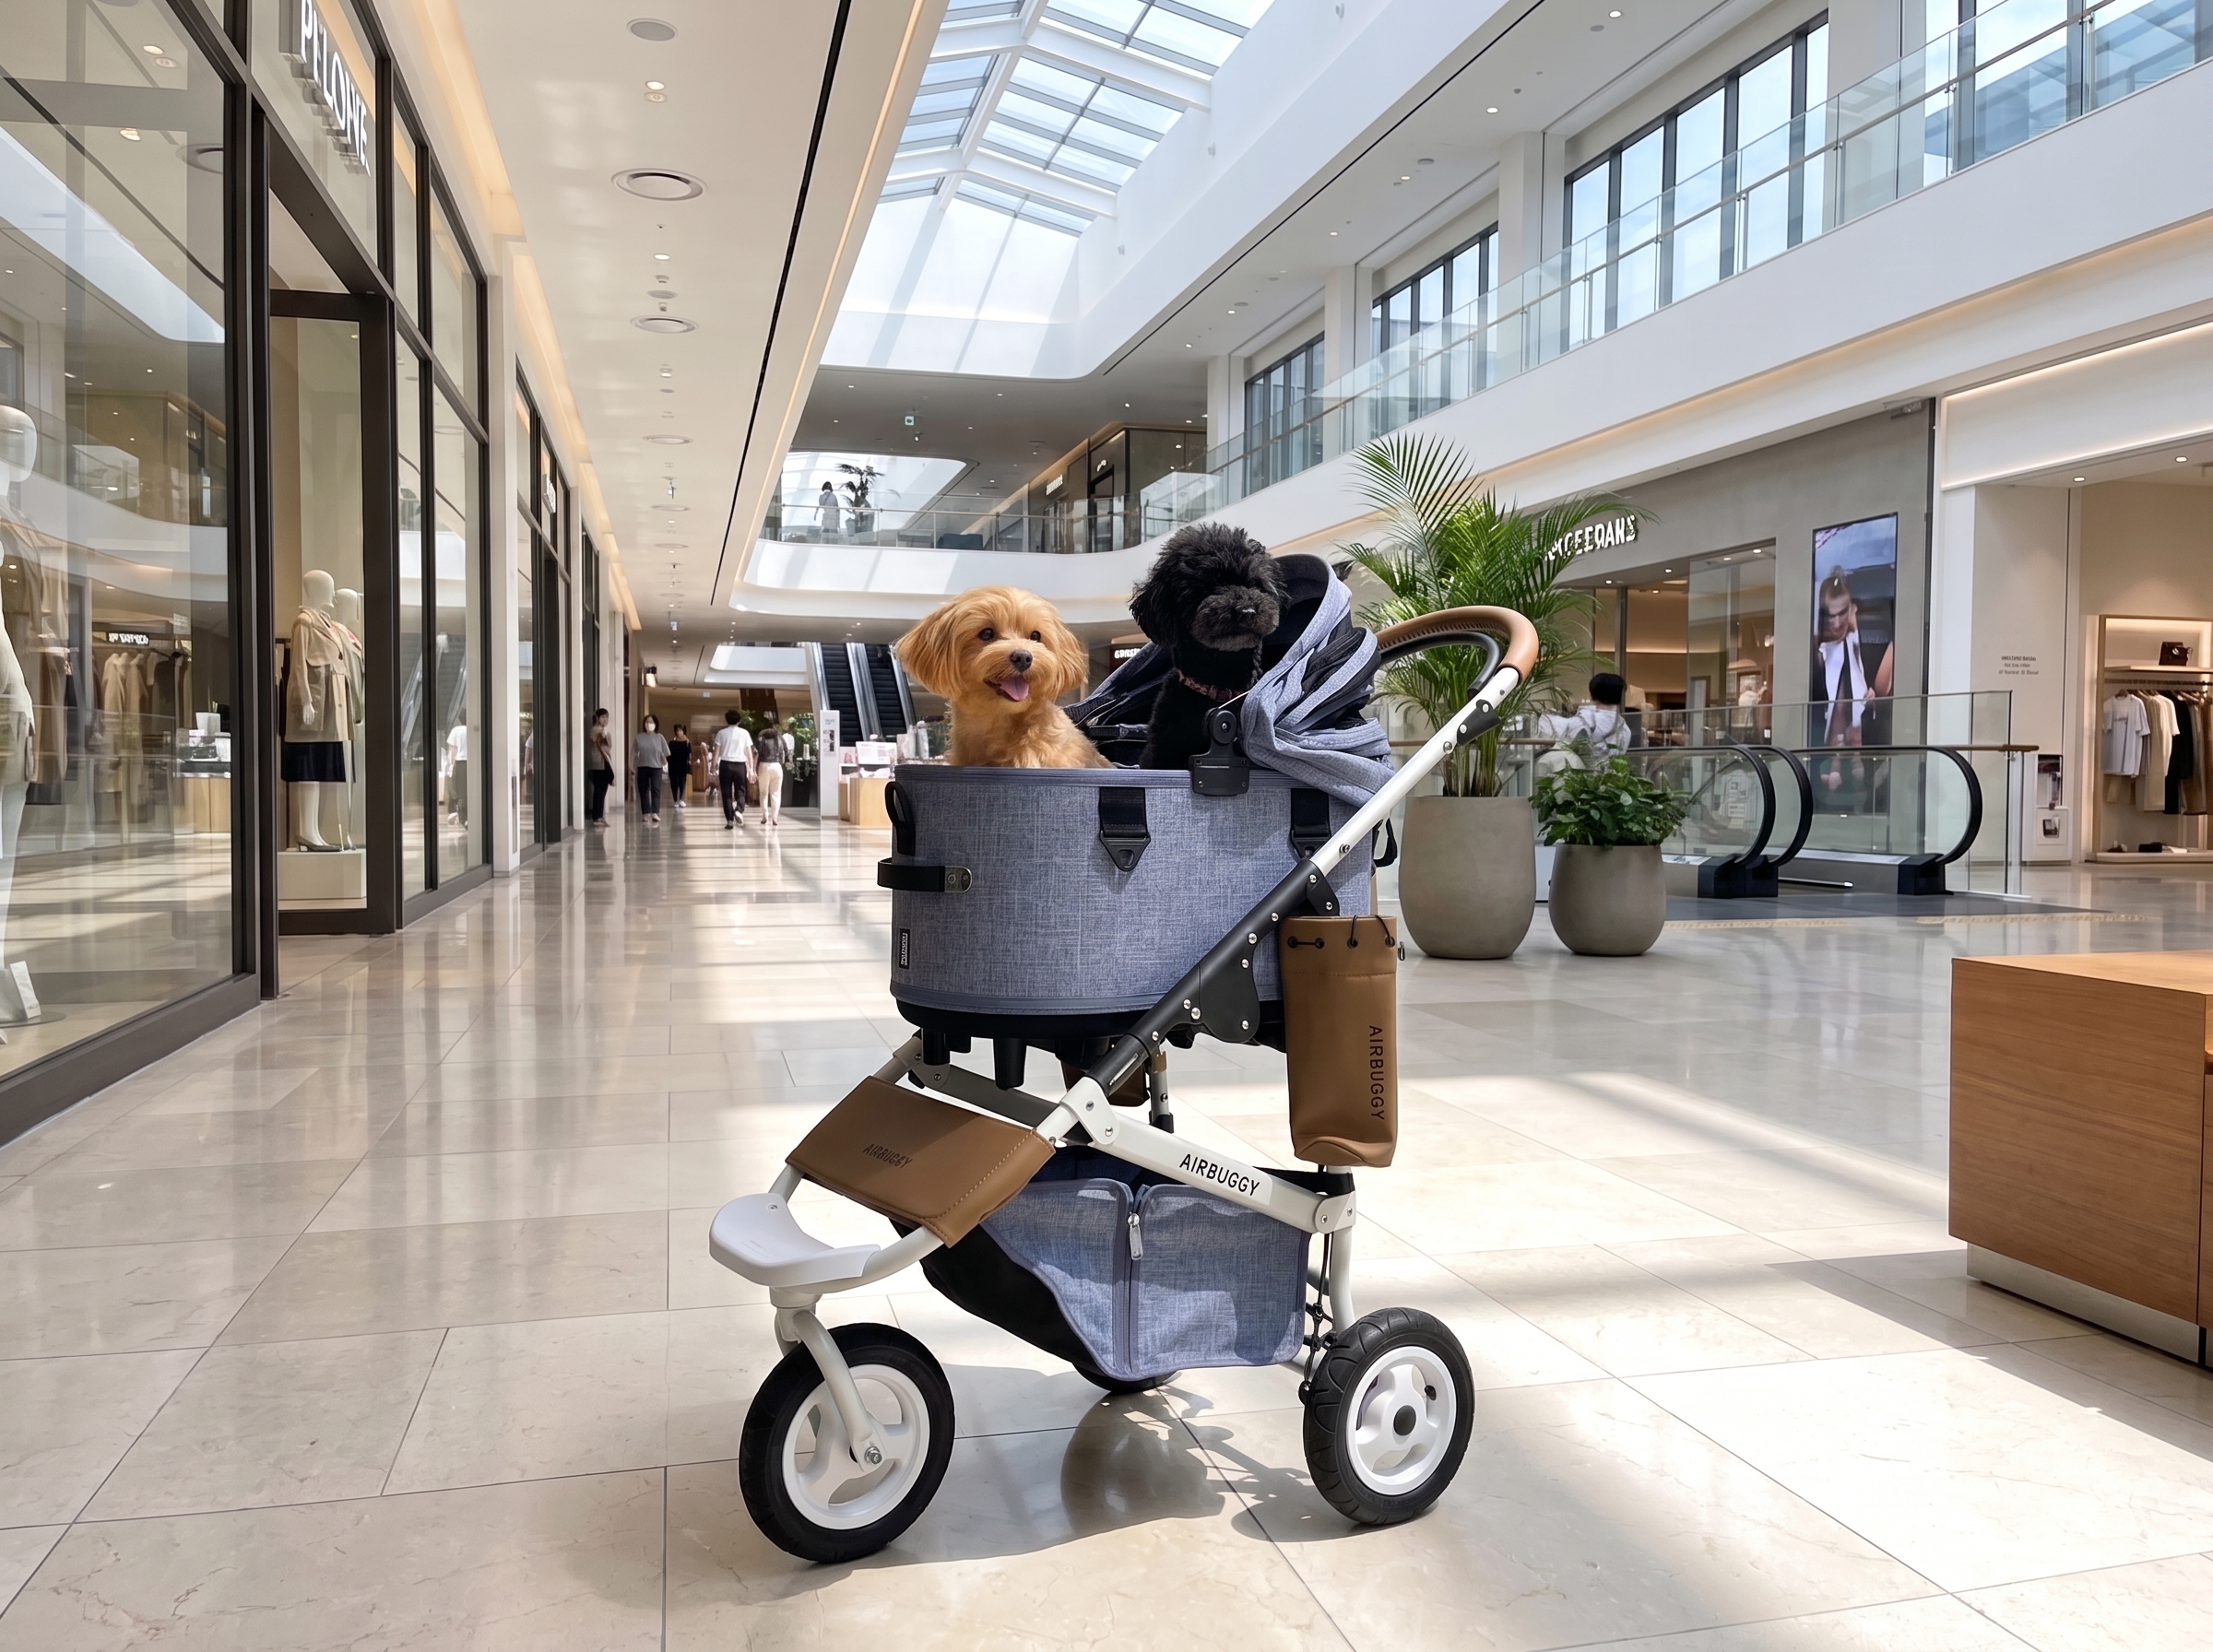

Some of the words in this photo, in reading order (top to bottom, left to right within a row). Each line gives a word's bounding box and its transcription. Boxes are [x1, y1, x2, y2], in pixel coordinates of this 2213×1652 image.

[1369, 1025, 1385, 1120] AIRBUGGY
[862, 1143, 913, 1169] AIRBUGGY
[1179, 1153, 1260, 1197] AIRBUGGY
